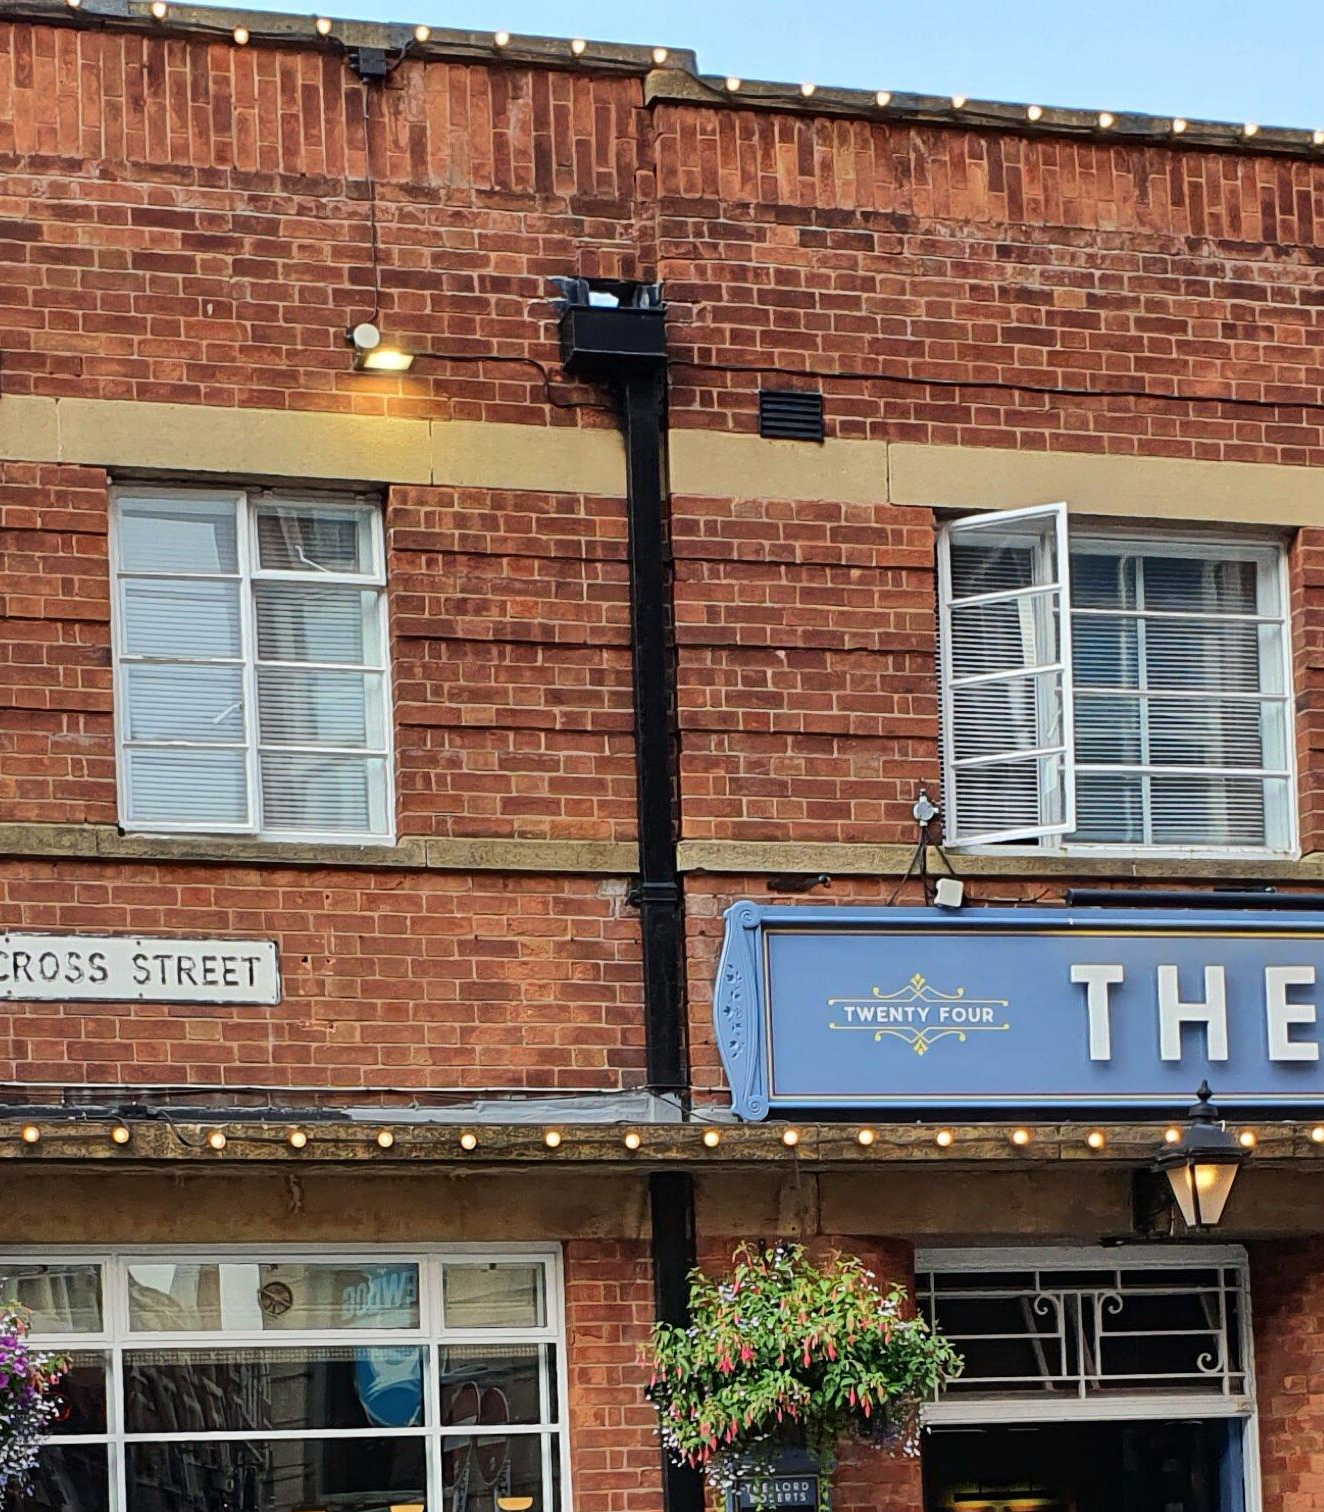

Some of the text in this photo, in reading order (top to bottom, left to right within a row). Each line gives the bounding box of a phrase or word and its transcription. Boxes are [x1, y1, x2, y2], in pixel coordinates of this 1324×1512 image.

[132, 954, 261, 988] STREET
[843, 1006, 994, 1023] TWENTY FOUR
[1070, 963, 1321, 1063] THE
[745, 1482, 809, 1494] TE LORD
